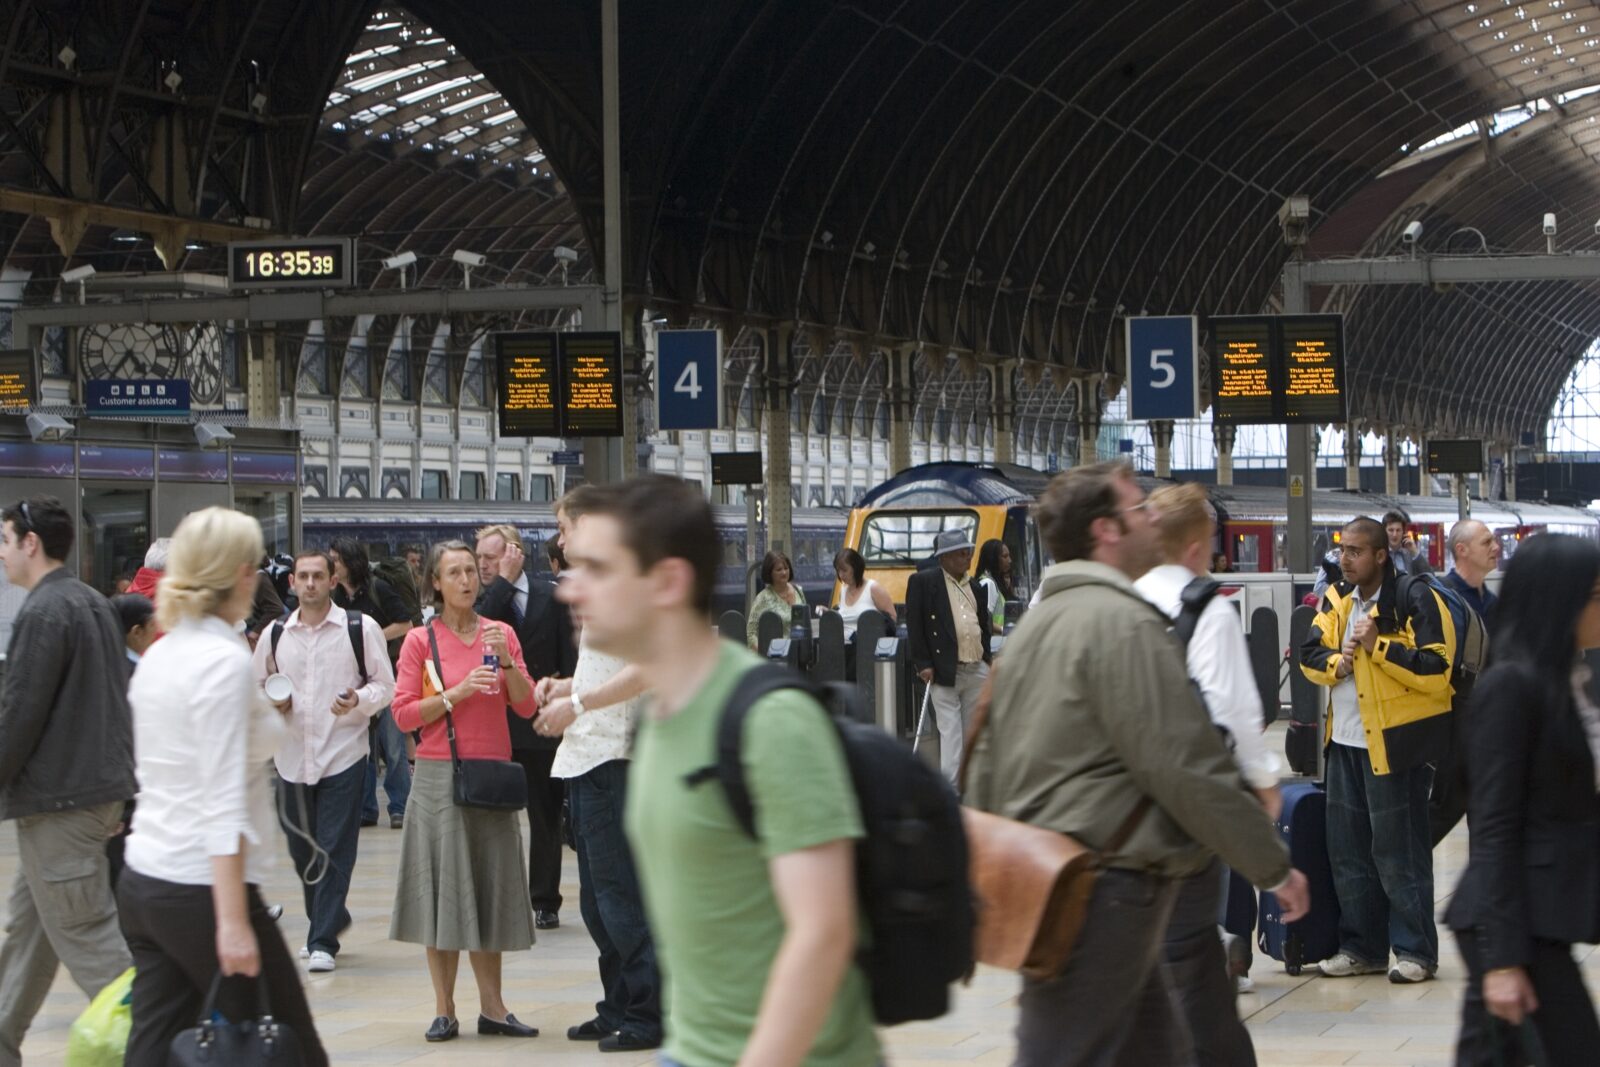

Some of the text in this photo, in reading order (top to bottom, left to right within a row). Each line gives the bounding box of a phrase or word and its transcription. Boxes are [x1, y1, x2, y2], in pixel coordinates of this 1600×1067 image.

[312, 255, 334, 275] 39
[1149, 349, 1176, 389] 5
[673, 361, 702, 400] 4
[99, 396, 177, 406] Customer assistance
[756, 500, 762, 522] 3
